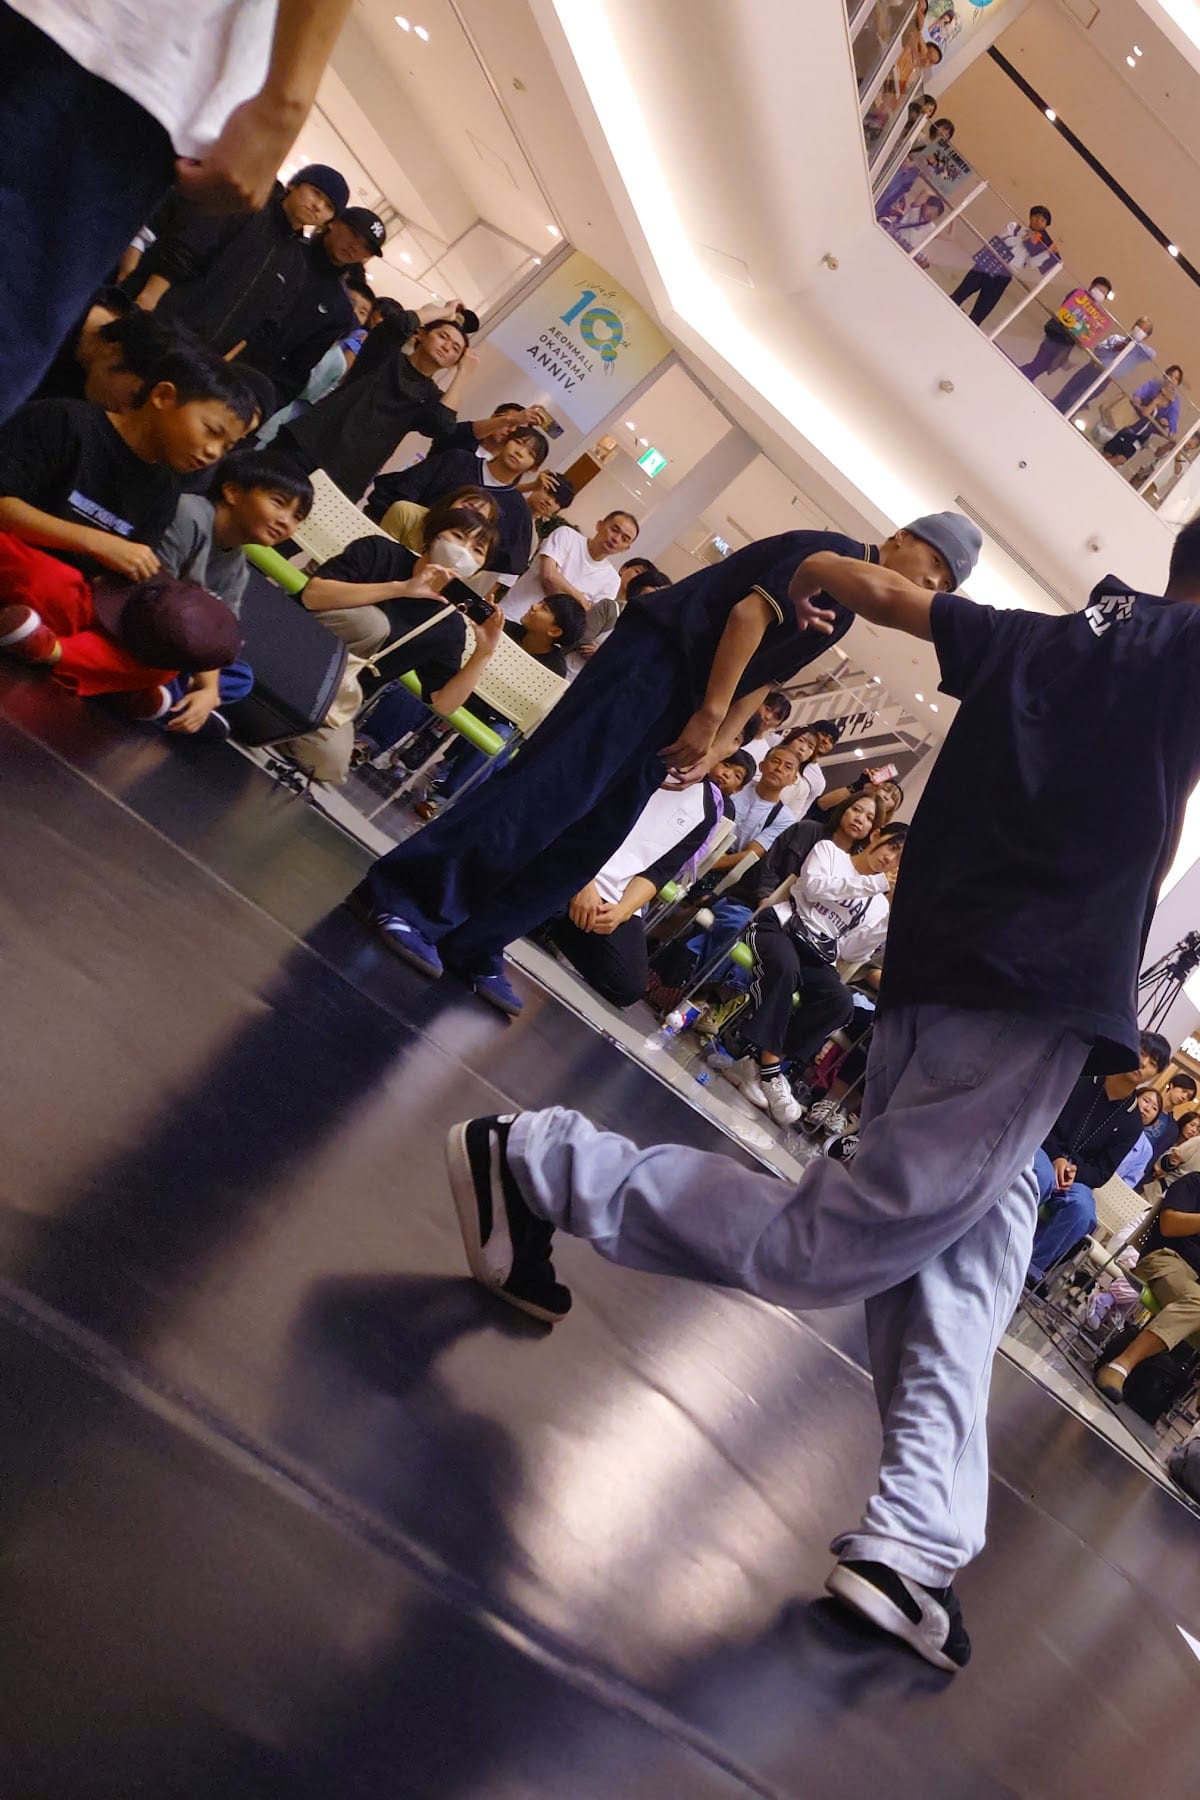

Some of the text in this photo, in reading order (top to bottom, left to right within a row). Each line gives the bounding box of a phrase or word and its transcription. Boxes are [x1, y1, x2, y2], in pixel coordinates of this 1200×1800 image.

[527, 345, 575, 393] ANNIV.
[539, 334, 586, 381] OKAYAMA
[548, 326, 594, 372] AEONMALL
